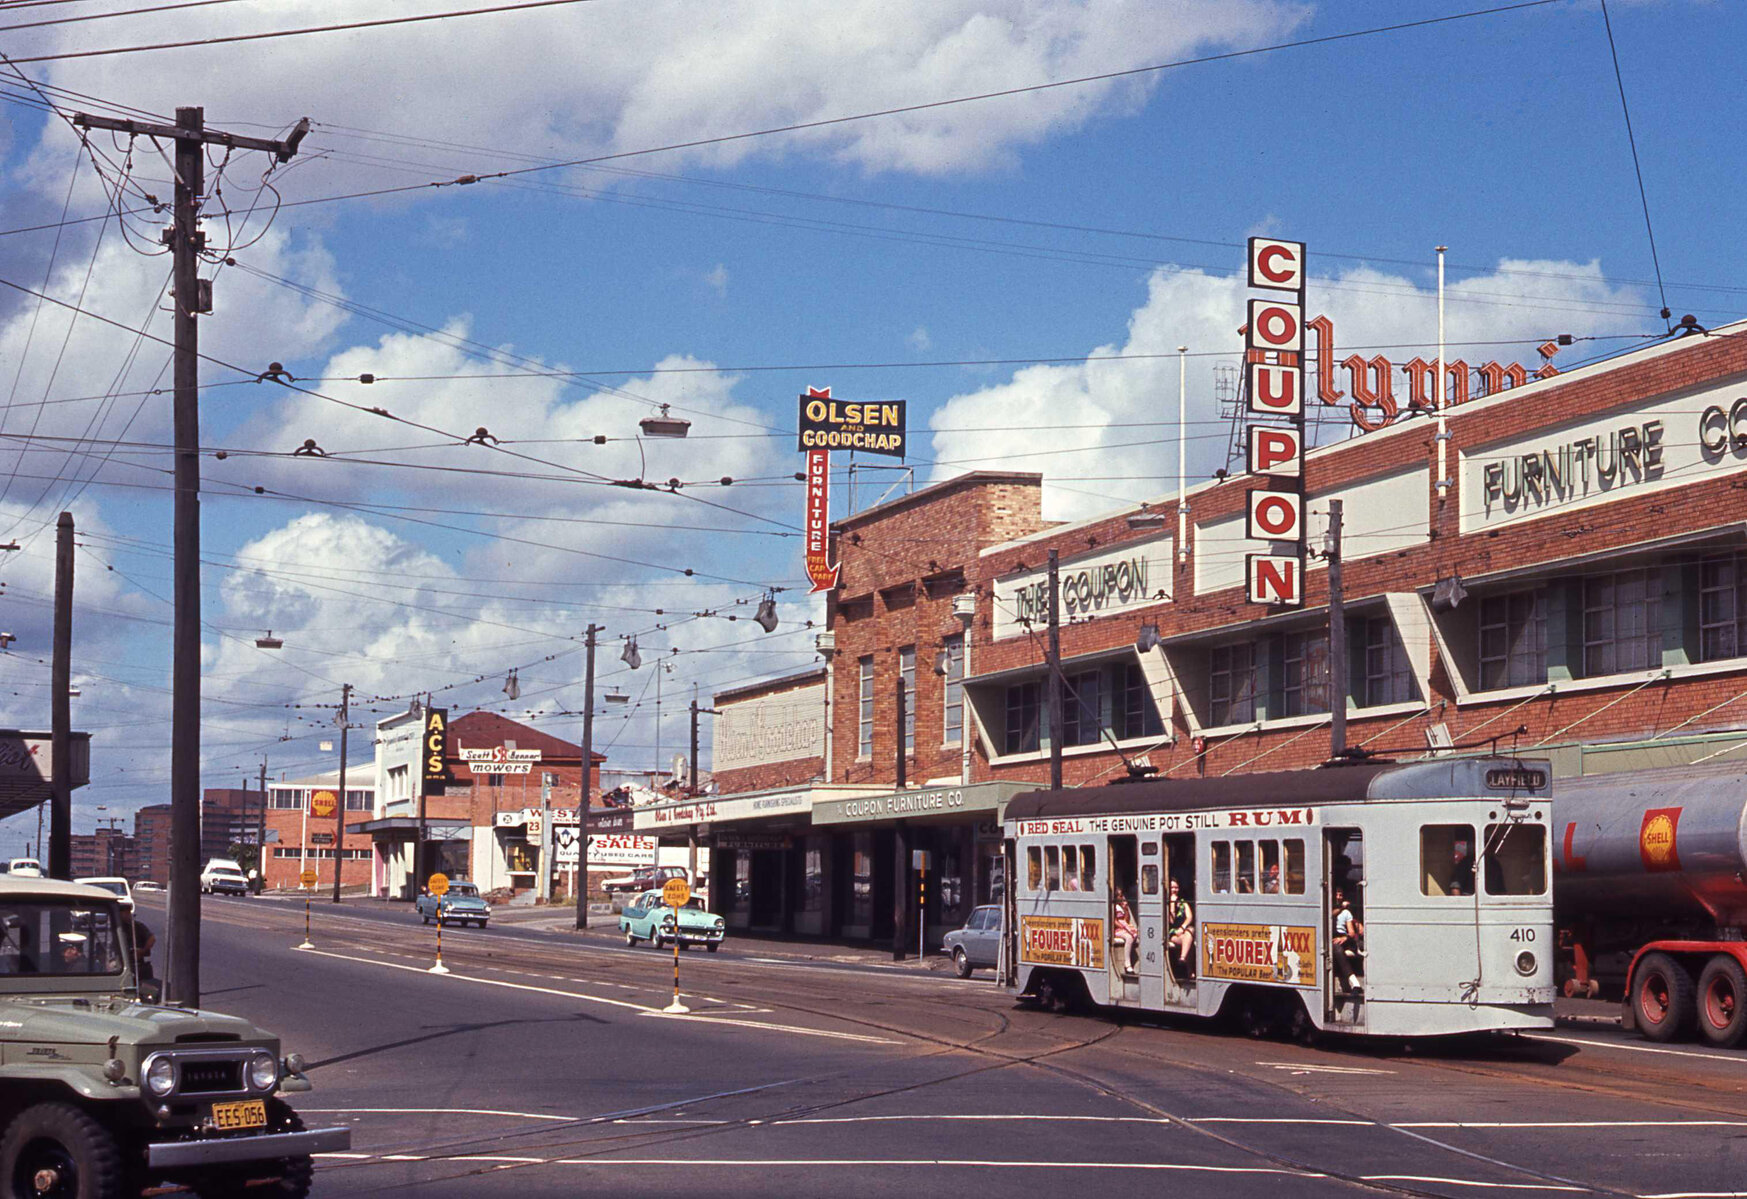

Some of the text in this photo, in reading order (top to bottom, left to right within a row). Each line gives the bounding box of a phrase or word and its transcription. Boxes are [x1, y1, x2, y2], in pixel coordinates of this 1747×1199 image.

[806, 401, 899, 426] OLSEN
[1257, 245, 1297, 600] COUPON
[840, 424, 864, 432] AND
[803, 430, 902, 450] GOODCHAP
[1484, 420, 1664, 505] FURNITURE
[812, 455, 823, 551] FURNITURE
[810, 564, 825, 572] CAR
[1063, 556, 1147, 607] COUPON
[466, 750, 490, 759] Scott
[473, 764, 529, 772] mowers
[845, 800, 882, 816] COUPON
[887, 793, 942, 812] FURNITURE
[529, 821, 540, 831] 23
[1027, 810, 1302, 834] RED SEAL THE GENUINE POT STILL RUM
[596, 840, 654, 850] SALES
[1647, 832, 1669, 844] SHELL
[1031, 929, 1074, 951] FOUREX
[1283, 932, 1311, 953] XXXX
[1510, 928, 1536, 943] 410
[1216, 938, 1274, 966] FOUREX
[1228, 967, 1257, 978] POPULAR
